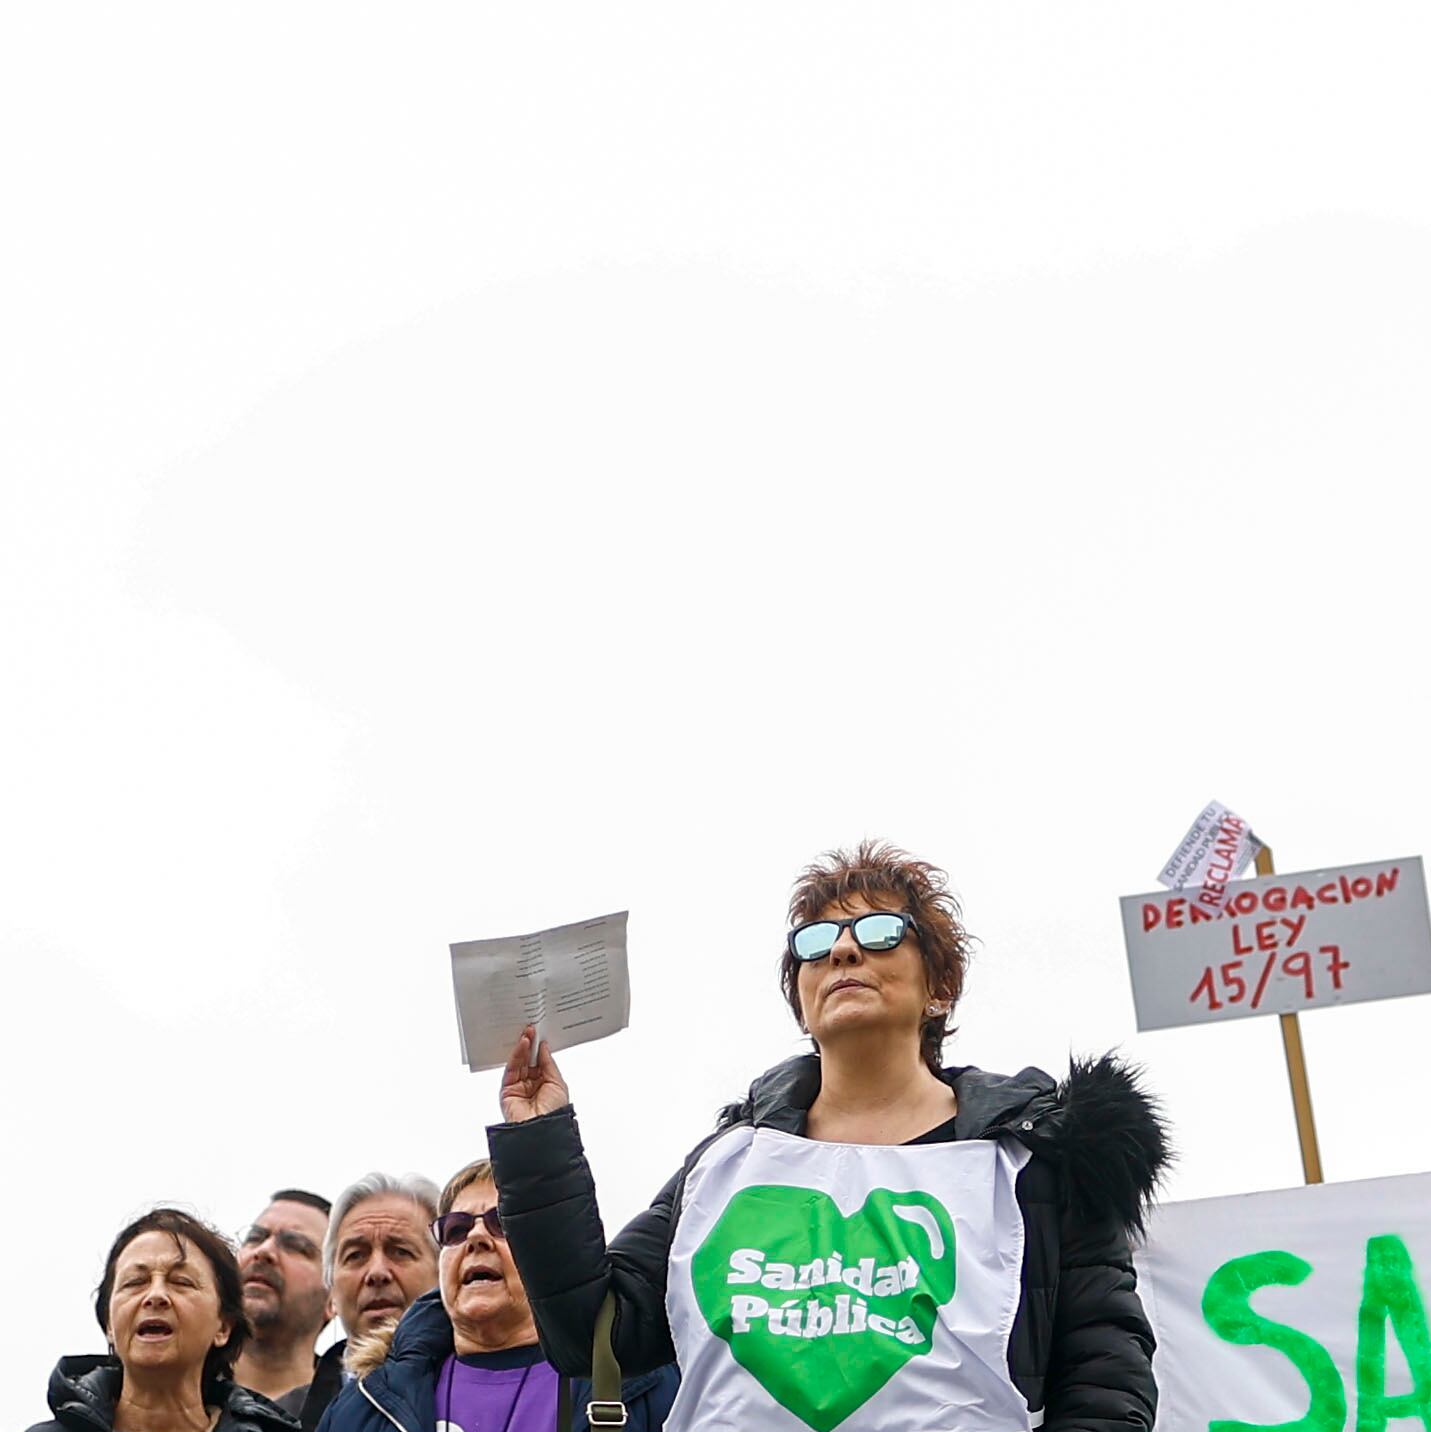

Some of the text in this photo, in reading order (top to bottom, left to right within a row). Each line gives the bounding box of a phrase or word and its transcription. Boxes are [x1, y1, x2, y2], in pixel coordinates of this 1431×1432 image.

[1165, 807, 1217, 878] DEFIENDE TU
[1198, 817, 1244, 907] RECLAMA
[1232, 915, 1306, 956] LEY
[1189, 945, 1350, 1010] 15/97
[730, 1294, 926, 1345] Pública
